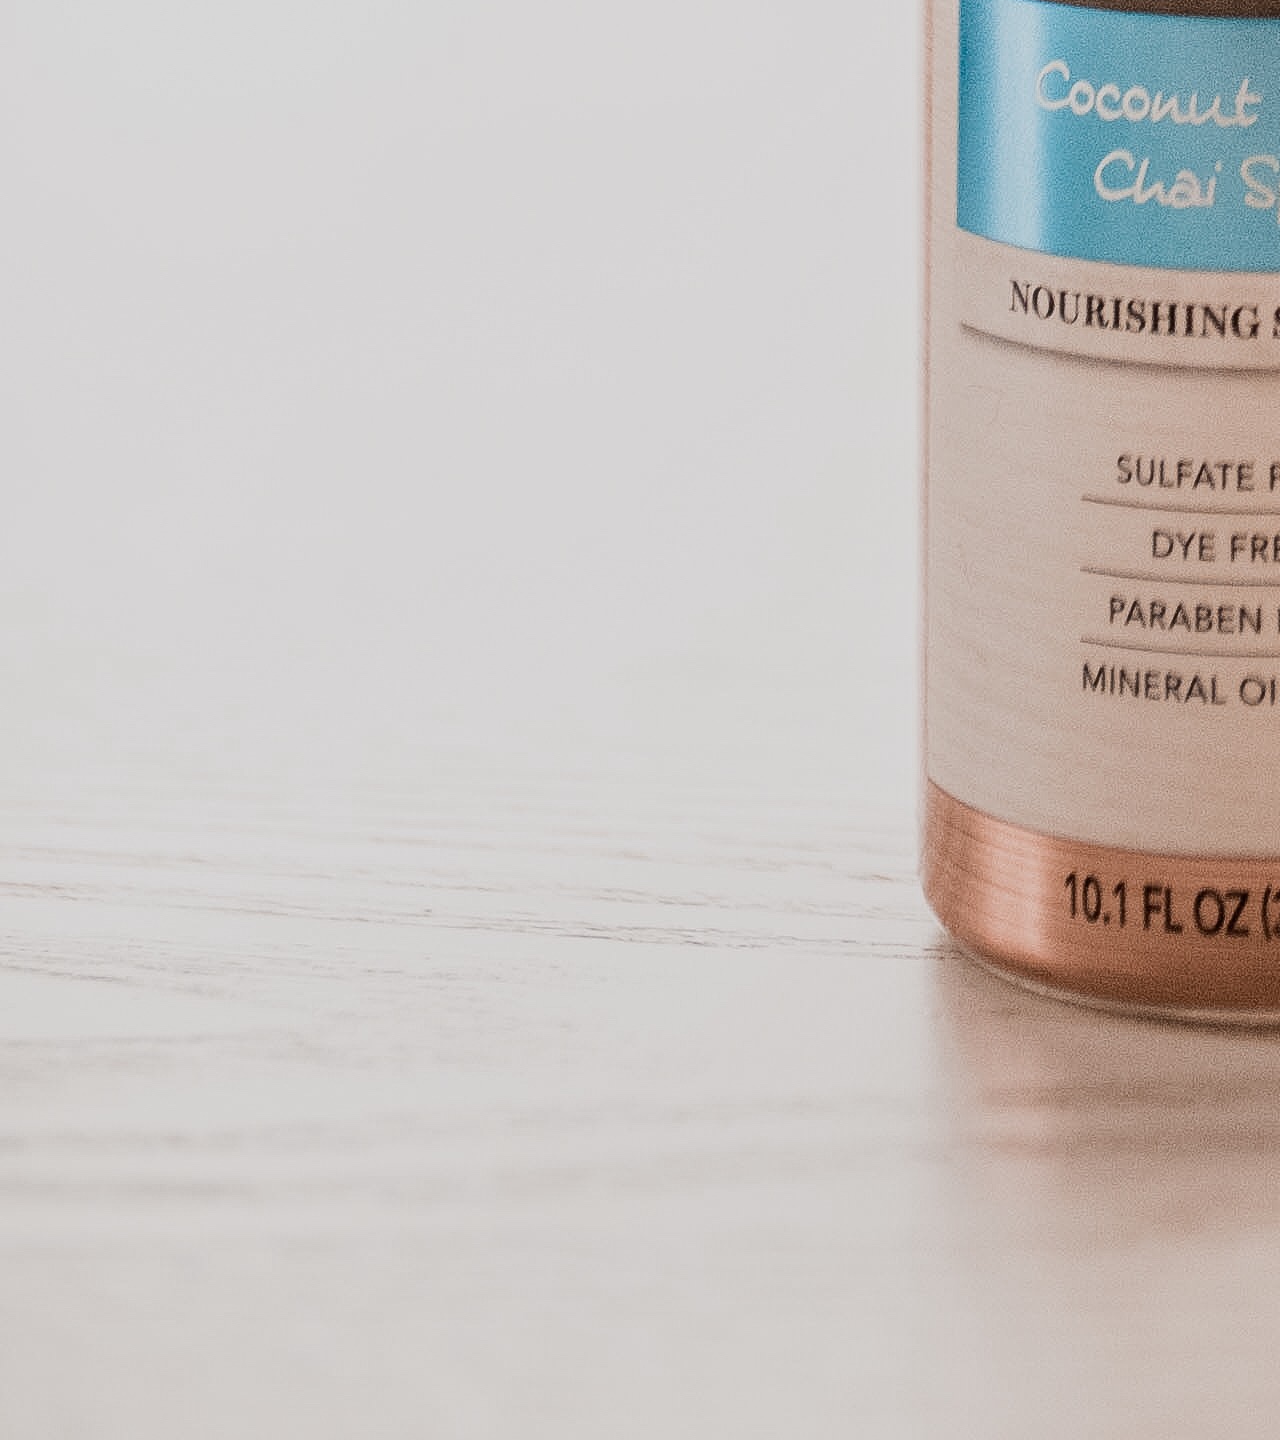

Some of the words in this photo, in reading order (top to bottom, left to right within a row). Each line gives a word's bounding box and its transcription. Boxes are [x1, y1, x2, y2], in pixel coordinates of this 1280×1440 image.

[1034, 60, 1258, 128] Coconut
[1093, 150, 1221, 210] Chai
[1008, 279, 1260, 340] NOURISHING
[1116, 454, 1256, 493] SULFATE
[1152, 529, 1216, 563] DYE
[1109, 596, 1263, 635] PARABEN
[1081, 663, 1227, 706] MINERAL
[1064, 872, 1128, 928] 10.1
[1142, 887, 1183, 935] FL
[1193, 891, 1251, 938] OZ
